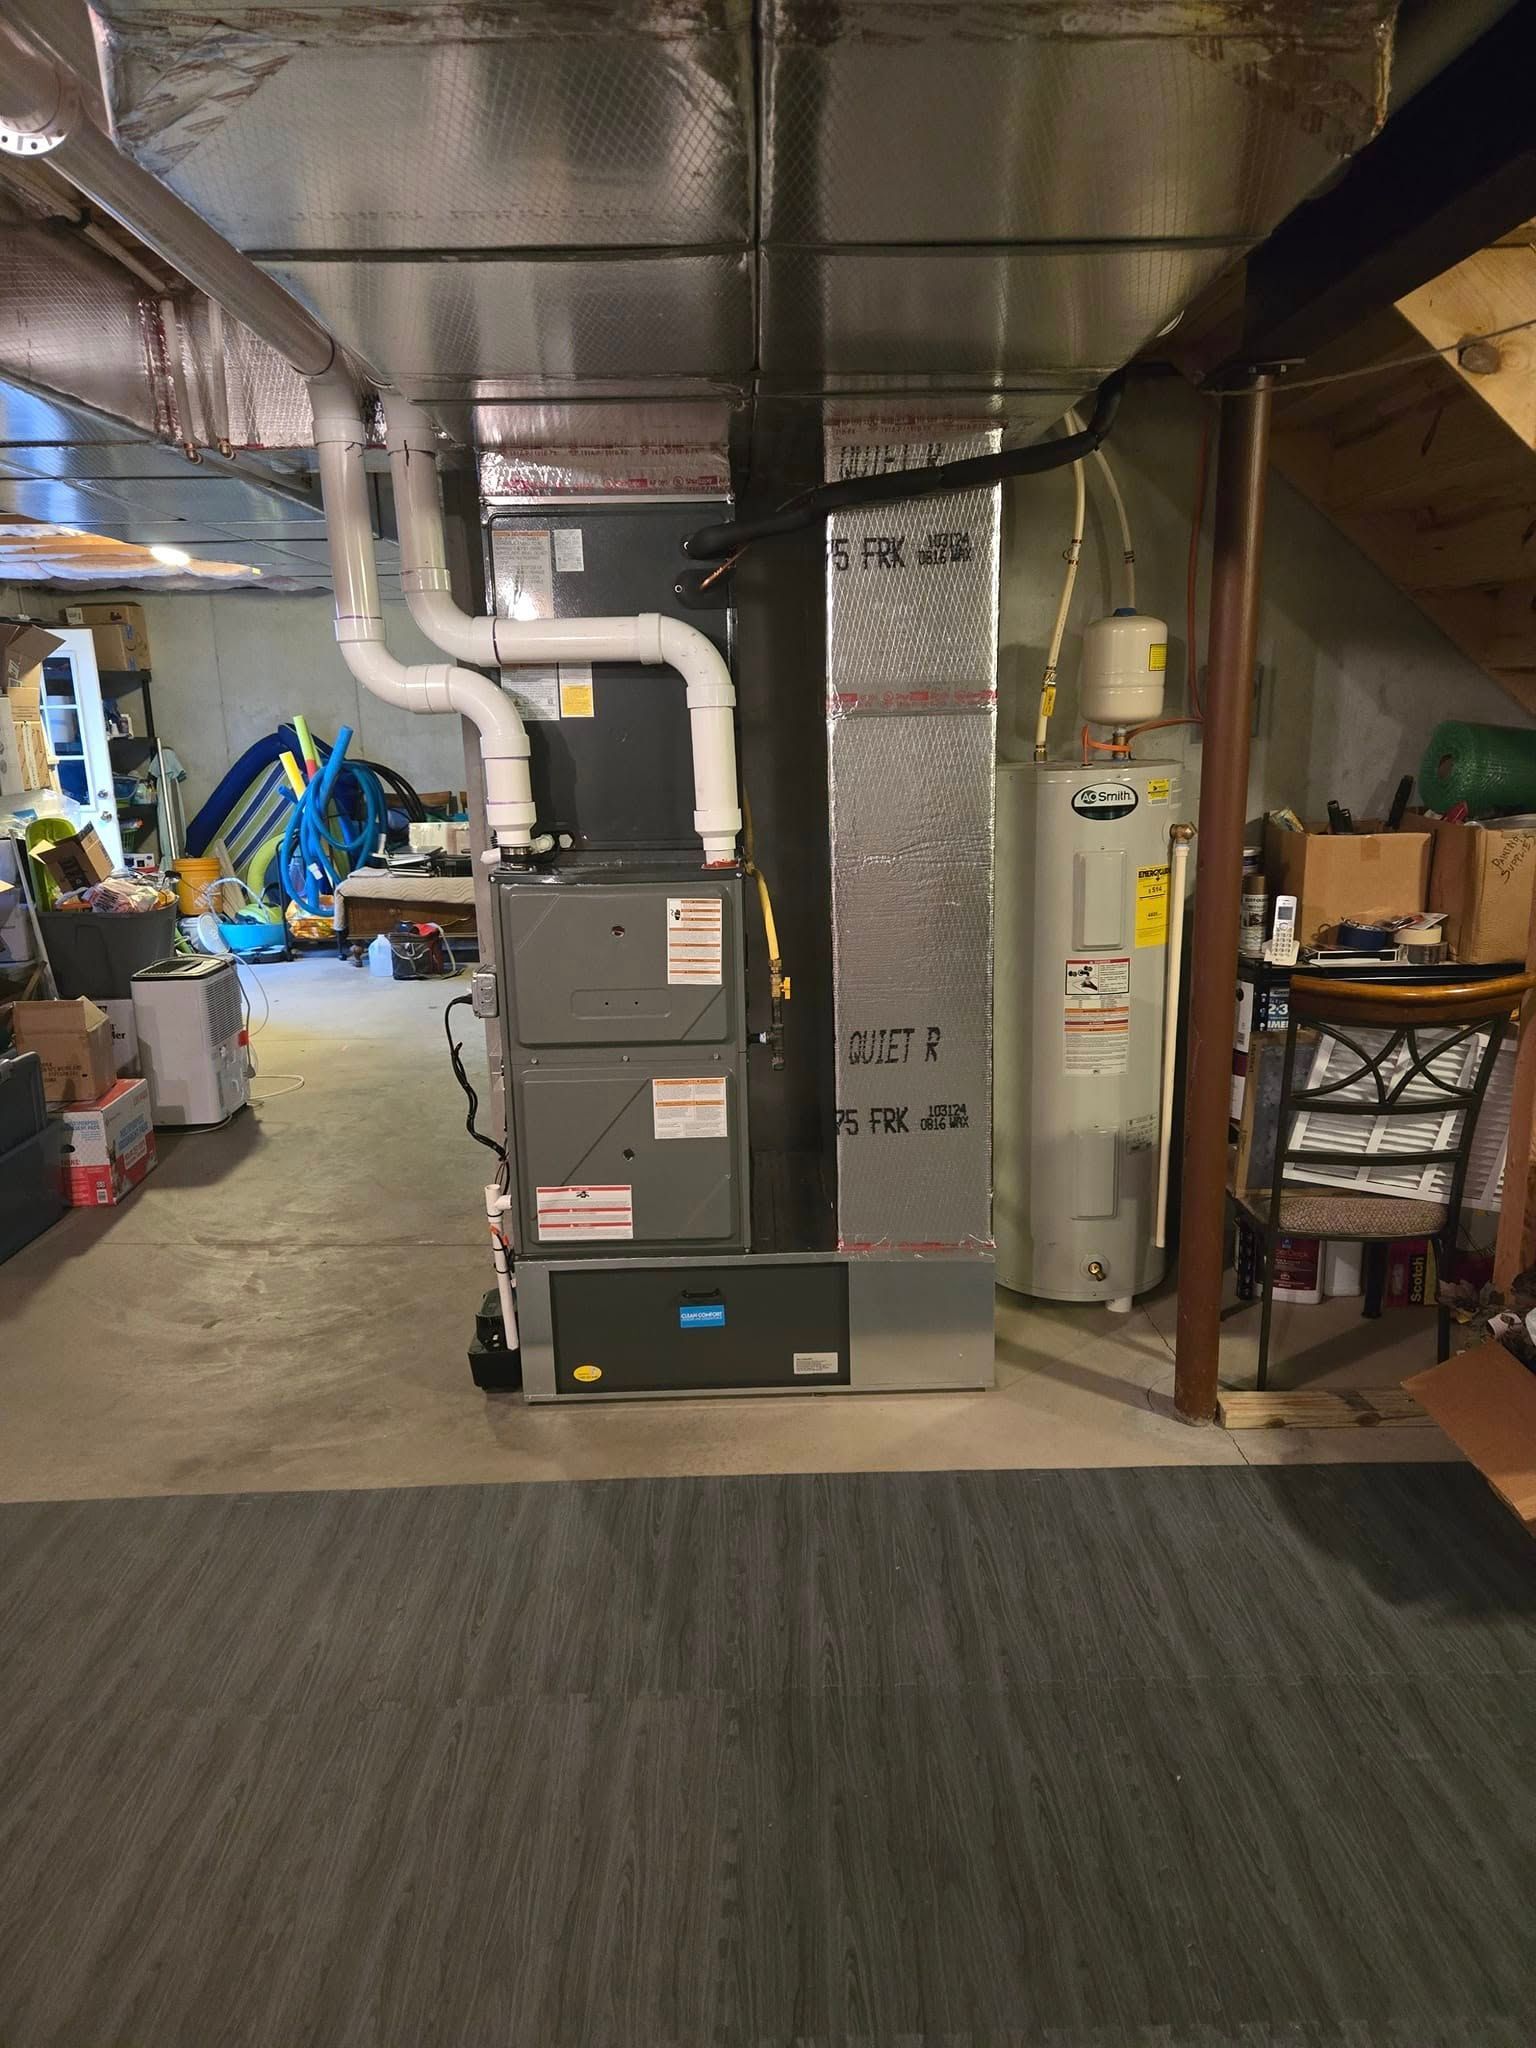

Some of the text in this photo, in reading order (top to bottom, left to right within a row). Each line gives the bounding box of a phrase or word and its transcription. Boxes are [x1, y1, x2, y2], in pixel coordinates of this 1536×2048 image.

[861, 536, 905, 570] FRK
[1098, 791, 1131, 802] Smith
[849, 1027, 941, 1065] QUIET R
[869, 1107, 909, 1134] FRK
[928, 1103, 967, 1117] 103124
[1410, 1257, 1424, 1302] Scotch
